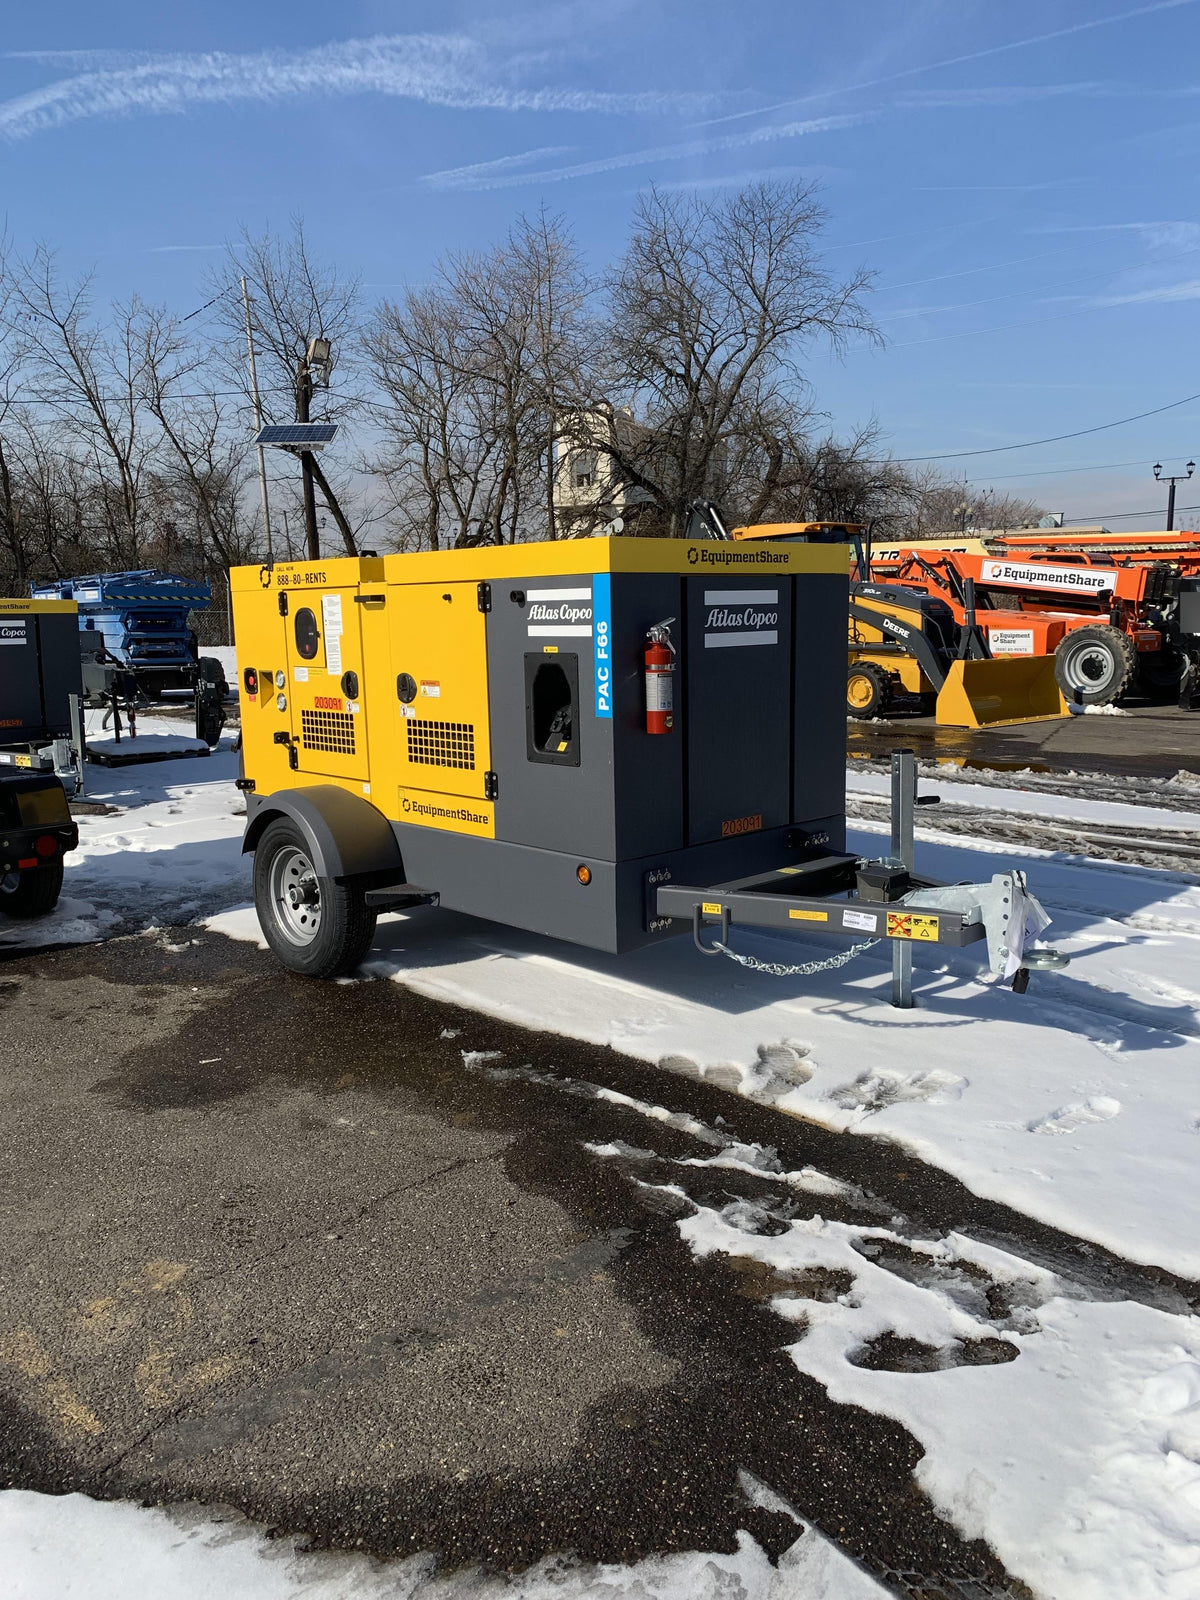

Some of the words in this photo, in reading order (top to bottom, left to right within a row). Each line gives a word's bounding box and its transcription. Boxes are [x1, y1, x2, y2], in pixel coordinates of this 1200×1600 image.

[701, 549, 789, 565] EquipmentShare
[277, 572, 327, 585] 888-80-RENTS
[1003, 567, 1105, 587] EquipmentShare
[527, 604, 559, 620] Atlas
[560, 604, 592, 622] Copco
[704, 608, 743, 628] Atlas
[743, 608, 778, 629] Copco
[1, 628, 26, 638] Copco
[883, 618, 910, 638] DEERE
[597, 621, 608, 659] F66
[598, 667, 609, 711] PAC
[314, 696, 342, 710] 203091
[412, 801, 489, 824] EquipmentShare
[723, 815, 762, 835] 203091
